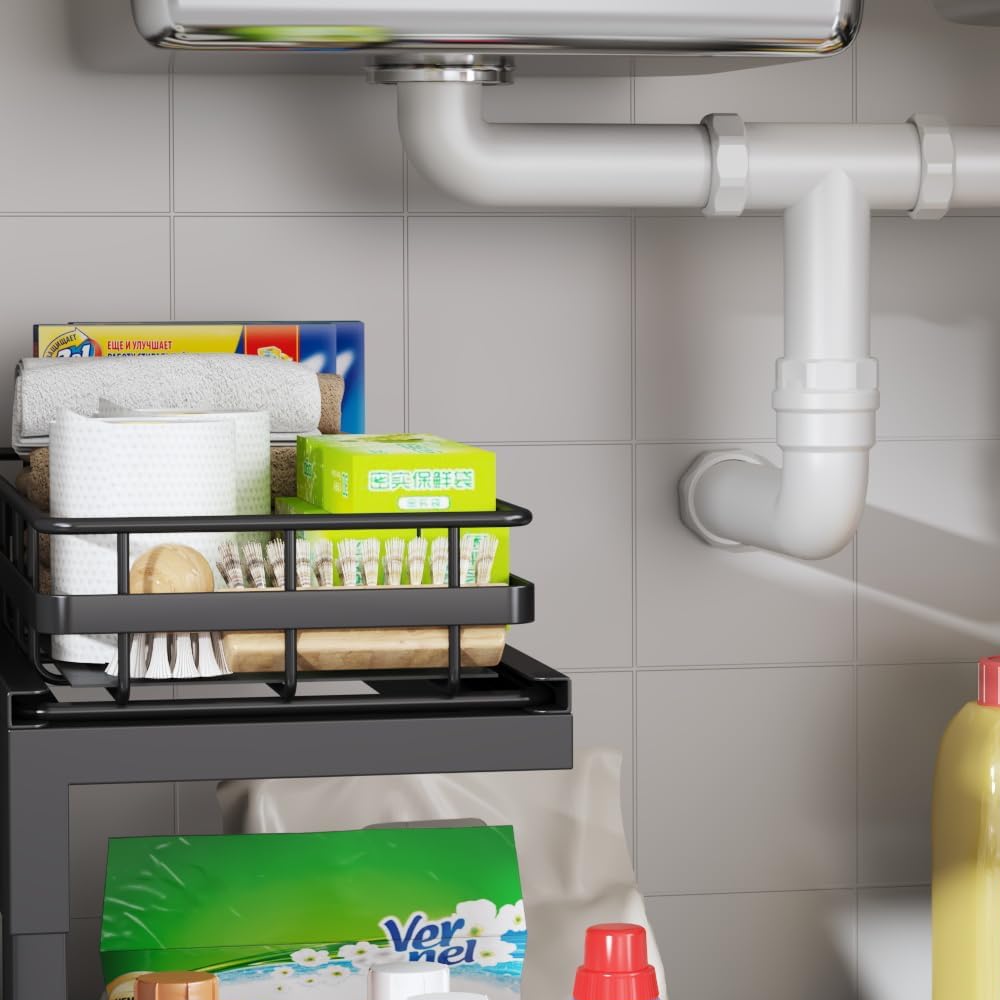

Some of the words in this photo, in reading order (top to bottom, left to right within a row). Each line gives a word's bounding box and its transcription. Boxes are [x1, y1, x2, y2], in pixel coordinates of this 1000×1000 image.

[47, 333, 77, 358] АЩИЩАЕТ
[107, 340, 123, 351] ЕЩЕ
[125, 340, 131, 350] И
[132, 340, 173, 351] УЛУЧШАЕТ
[383, 914, 466, 953] Ver
[408, 938, 478, 966] nel
